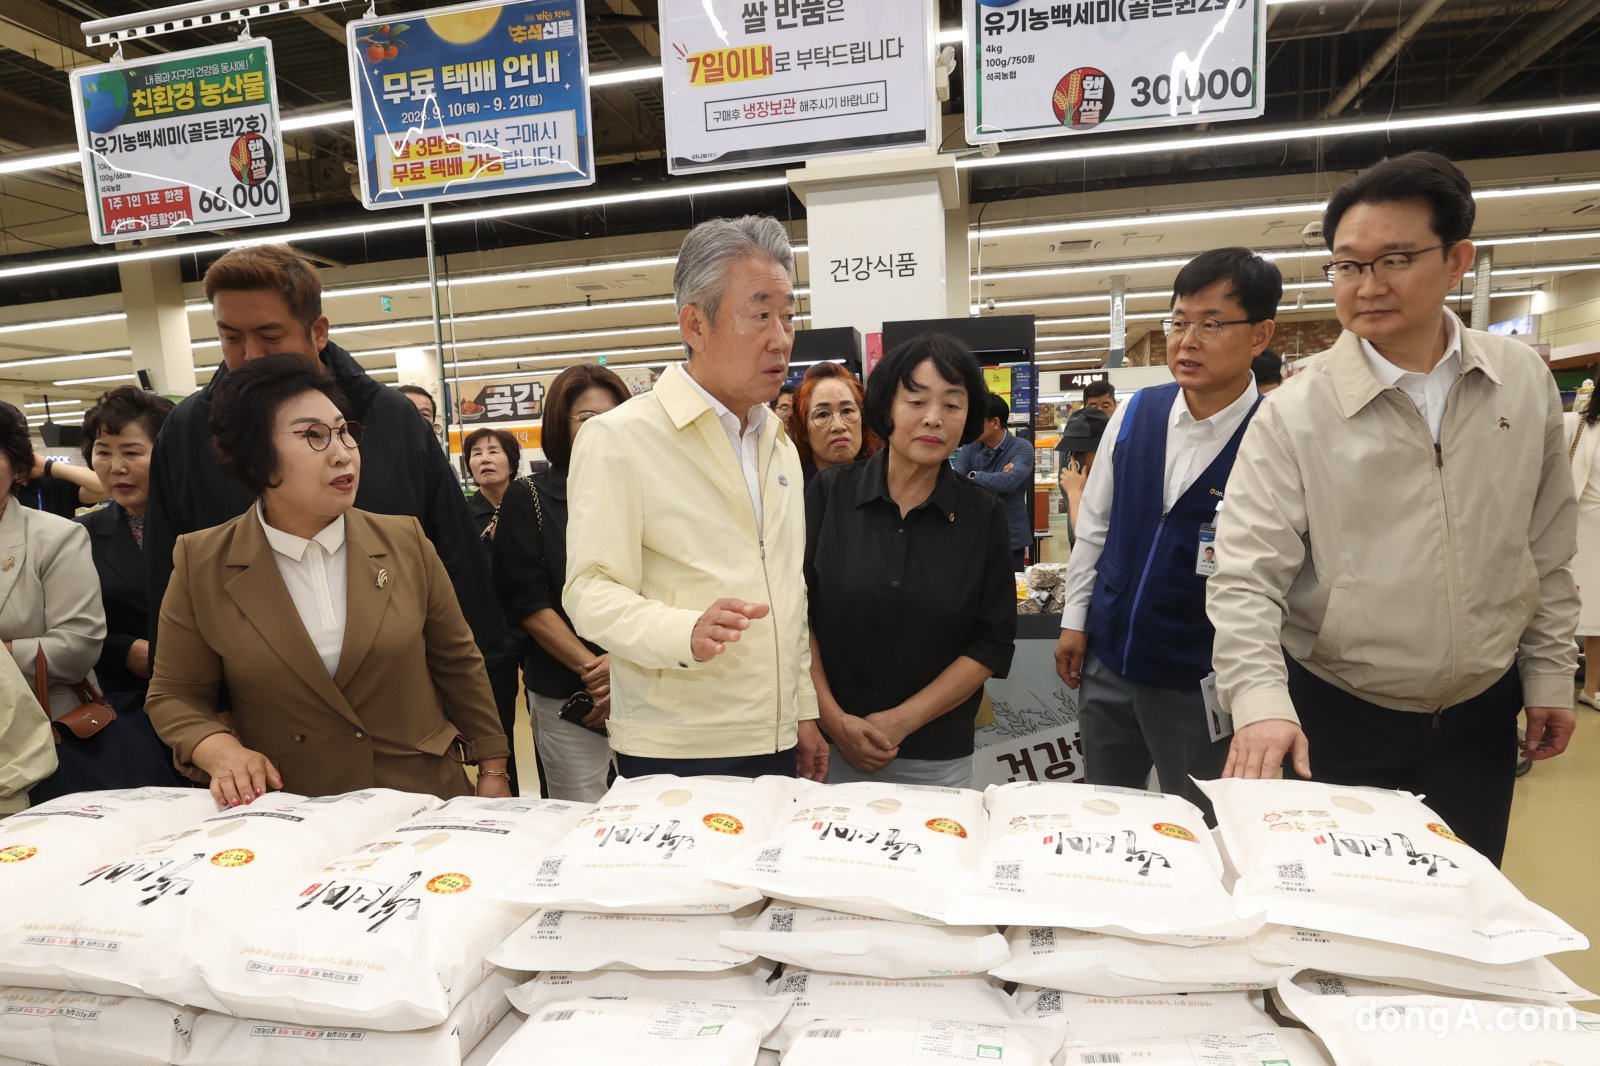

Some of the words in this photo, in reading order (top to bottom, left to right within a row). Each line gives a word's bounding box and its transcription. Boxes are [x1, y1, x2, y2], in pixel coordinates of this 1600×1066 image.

[508, 19, 574, 43] 추석선물
[742, 0, 768, 35] 쌀
[775, 0, 845, 30] 반품은
[984, 0, 1246, 36] 유기농백세미(골든퀸2
[687, 45, 791, 84] 7일이내로
[797, 37, 904, 70] 부탁드립니다
[985, 44, 1003, 55] 4kg
[985, 54, 1035, 67] 100g/750원
[172, 67, 195, 81] 지구의
[196, 64, 219, 78] 건강을
[221, 60, 249, 73] 동시에!
[383, 68, 437, 104] 무료
[442, 59, 497, 95] 택배
[503, 50, 560, 88] 안내
[986, 71, 1017, 82] 석곡농협
[1131, 66, 1252, 107] 30,000
[132, 81, 195, 117] 친환경
[200, 71, 265, 107] 농산물
[448, 102, 480, 118] 10(목)
[493, 97, 507, 111] 9.
[510, 93, 543, 109] 21(월)
[713, 109, 741, 123] 구매후
[743, 98, 796, 119] 냉장보관
[800, 97, 838, 113] 해주시기
[840, 92, 880, 108] 바랍니다
[1079, 75, 1105, 124] 햅쌀
[94, 113, 268, 154] 유기농백세미(골든퀸2호)
[394, 140, 410, 159] 쌀
[416, 132, 461, 157] 3만원
[465, 127, 499, 150] 이상
[505, 120, 557, 145] 구매시
[248, 138, 267, 180] 햅쌀
[393, 161, 425, 182] 무료
[430, 156, 464, 177] 택배
[108, 197, 122, 210] 1주
[127, 194, 141, 208] 1인
[145, 192, 160, 205] 1포
[164, 188, 183, 203] 한정
[199, 180, 278, 214] 66,000
[830, 252, 918, 283] 건강식품
[484, 382, 544, 418] 곶감
